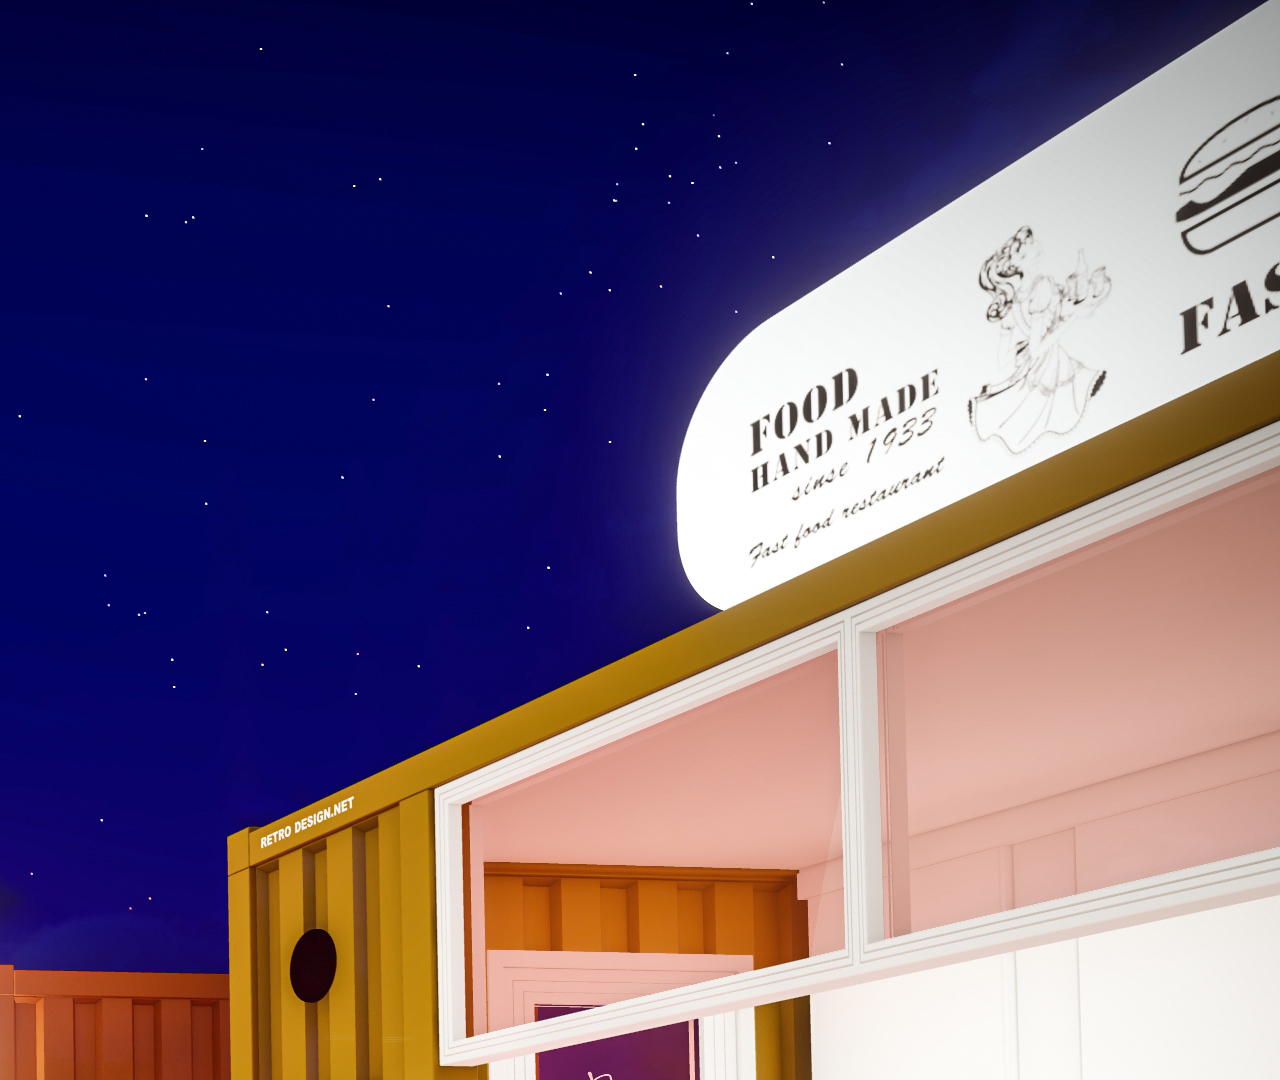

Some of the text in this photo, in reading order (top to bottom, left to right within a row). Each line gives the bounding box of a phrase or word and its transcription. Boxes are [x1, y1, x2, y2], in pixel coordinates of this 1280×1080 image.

[749, 367, 859, 456] FOOD
[749, 368, 940, 493] HAND MADE
[791, 407, 936, 501] sinse 1933
[749, 457, 945, 568] Fast food restaurant
[260, 796, 354, 848] RETRO DESIGN.NET
